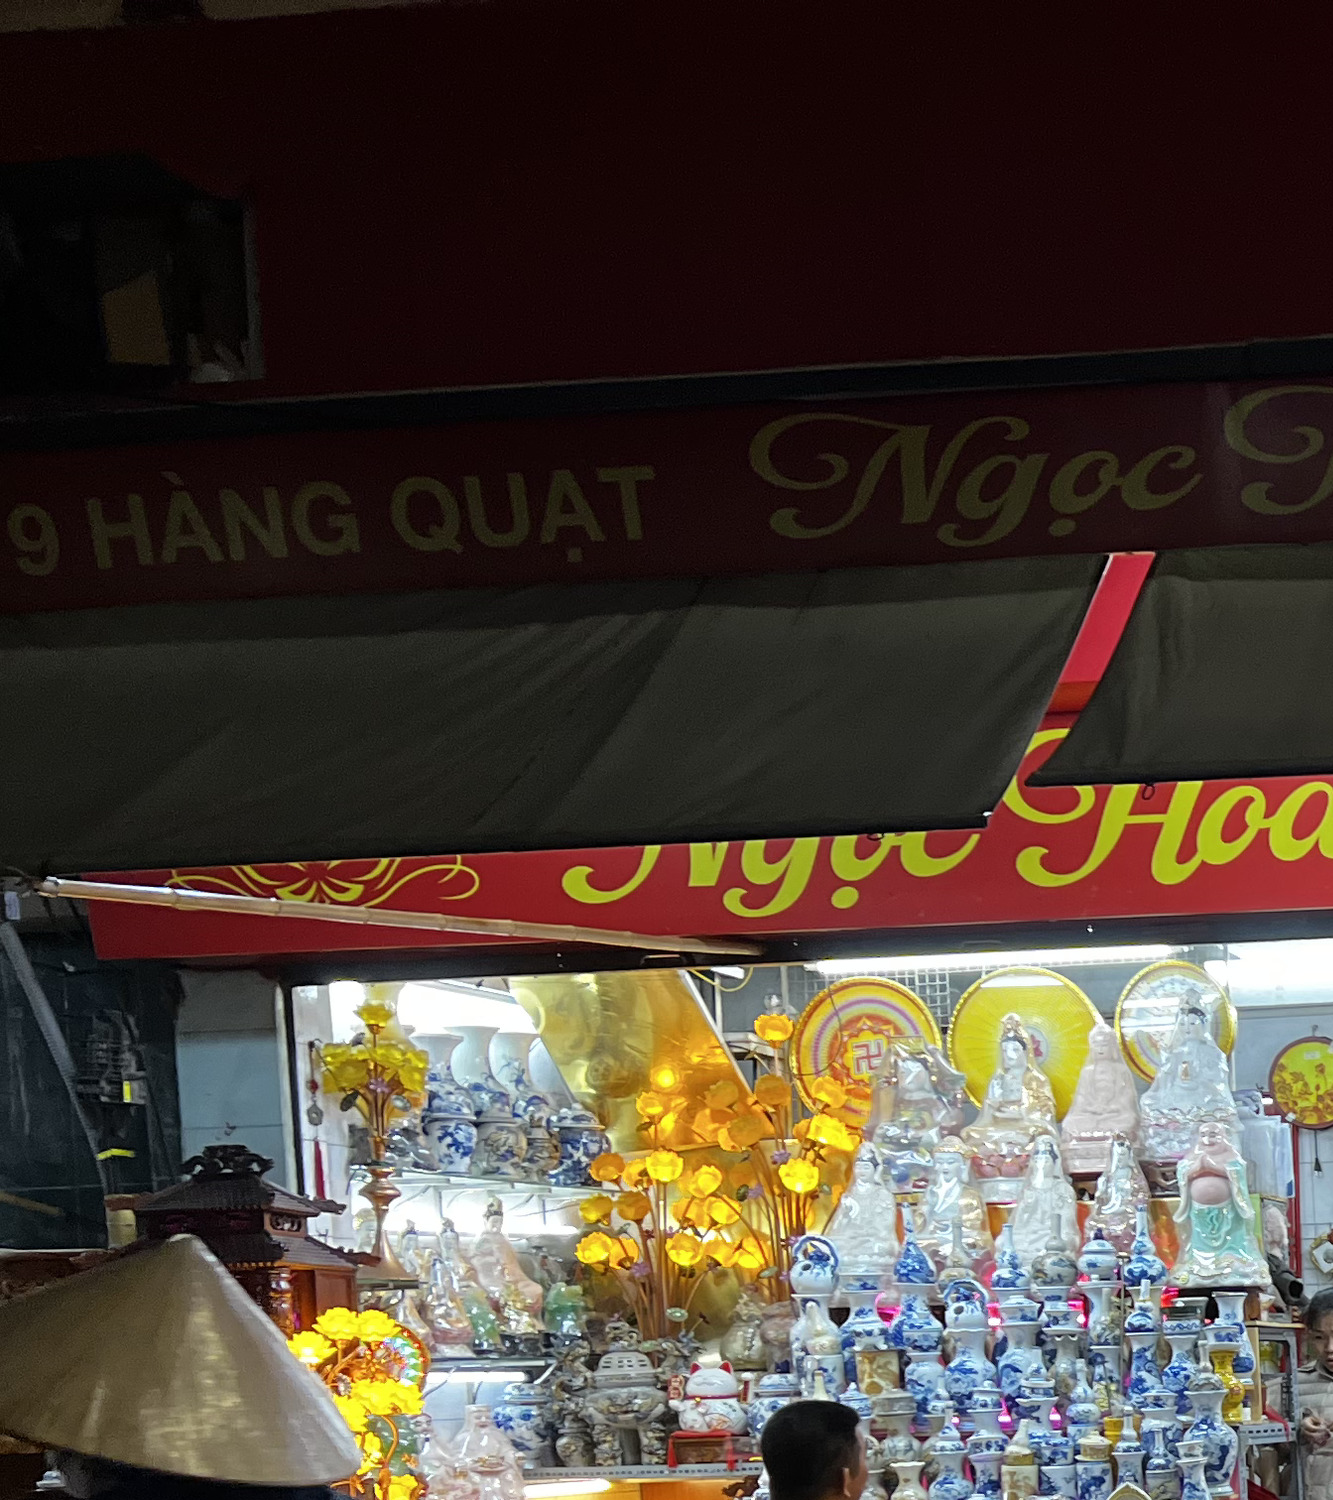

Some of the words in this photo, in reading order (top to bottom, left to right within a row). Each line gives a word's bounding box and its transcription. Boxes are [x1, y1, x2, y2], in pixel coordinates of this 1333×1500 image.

[7, 503, 61, 577] 9
[85, 470, 362, 570] HÀNG
[388, 464, 656, 564] QUẠT
[747, 411, 1202, 546] Ngọc
